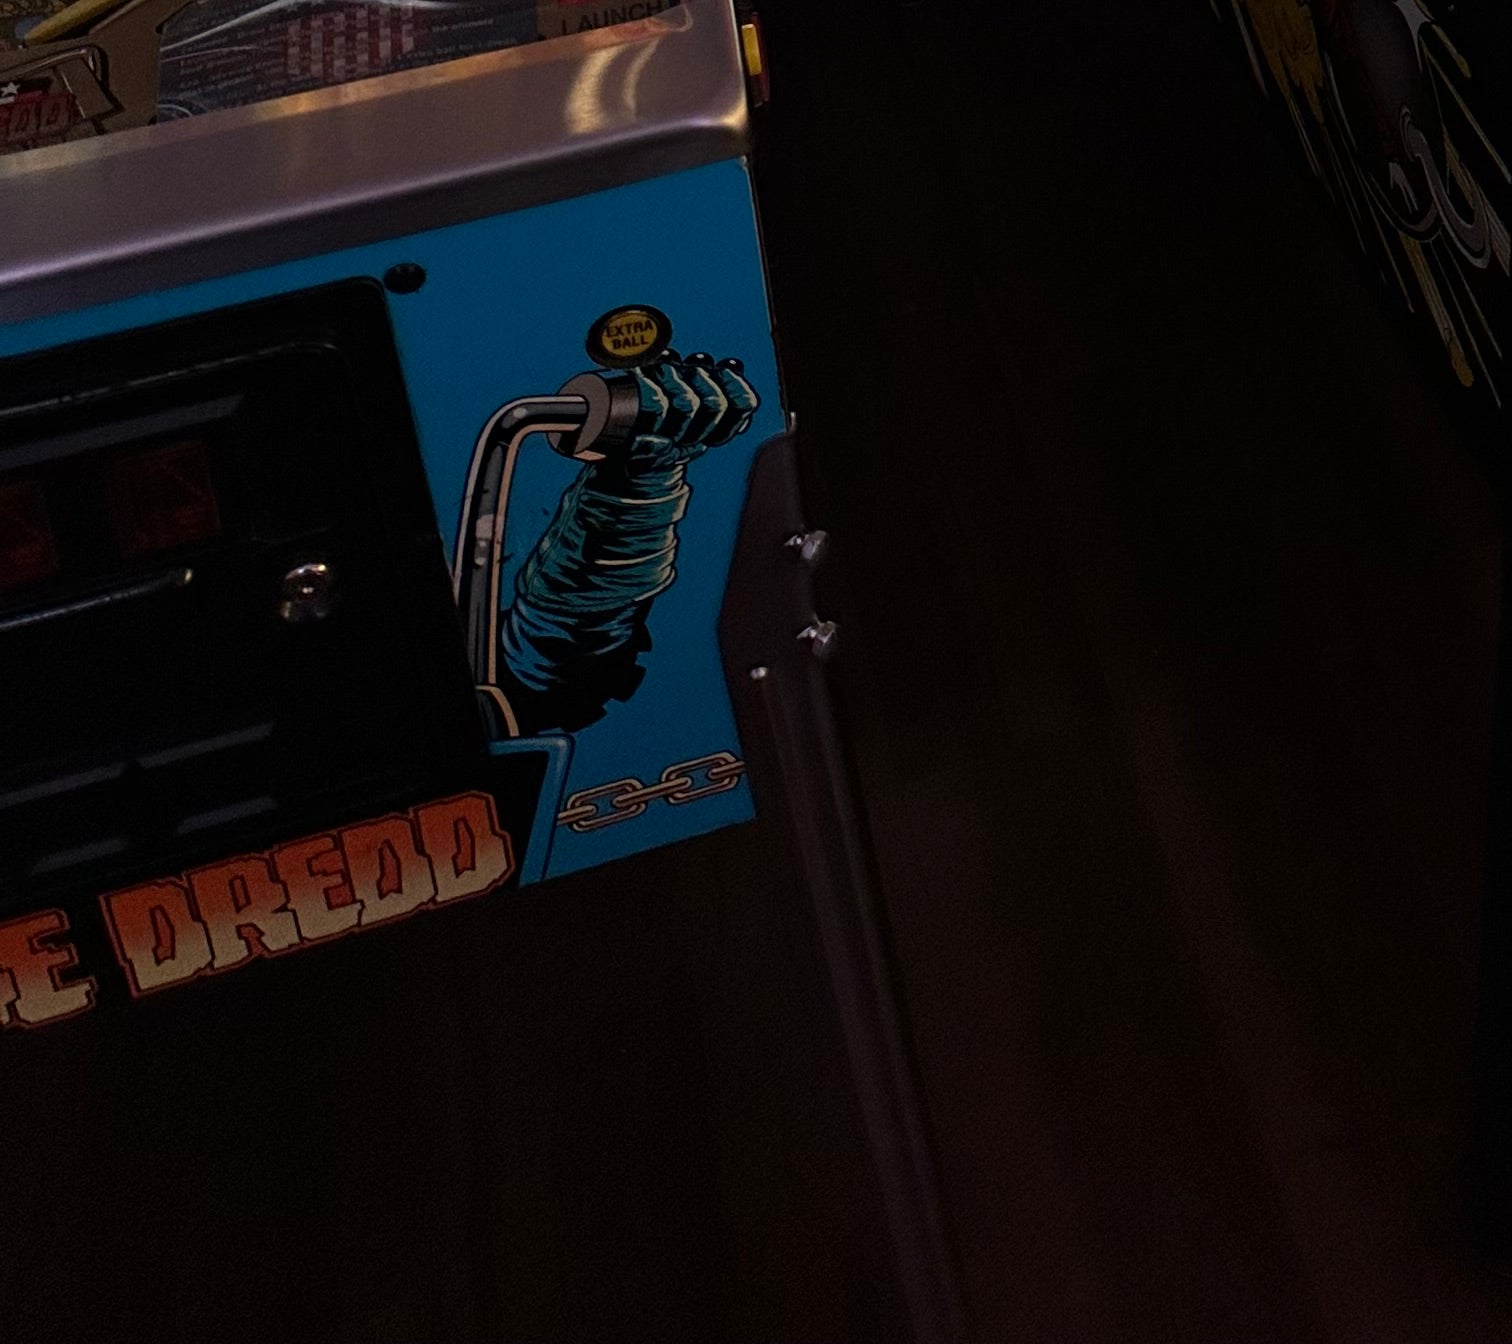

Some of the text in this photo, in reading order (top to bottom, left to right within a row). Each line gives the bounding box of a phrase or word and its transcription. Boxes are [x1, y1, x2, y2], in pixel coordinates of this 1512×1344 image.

[561, 0, 664, 36] LAUNCH
[605, 316, 656, 342] EXTRA
[611, 330, 651, 353] BALL
[102, 788, 517, 997] DREDD
